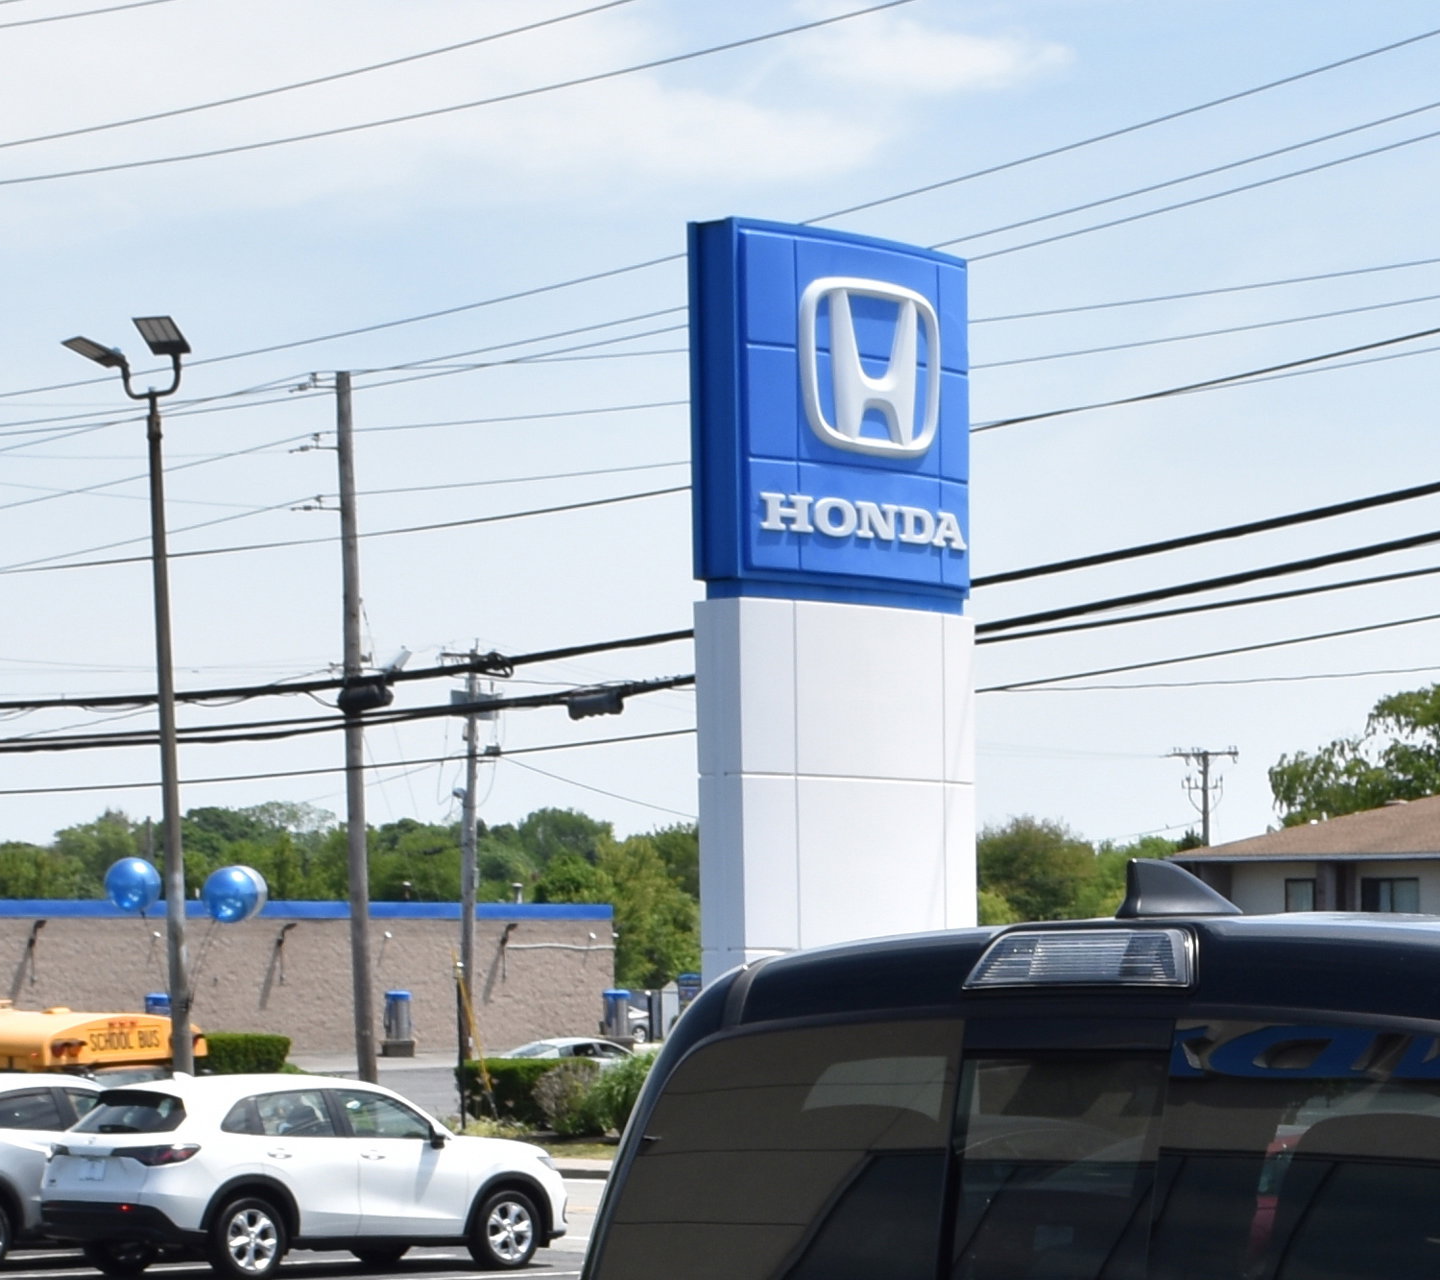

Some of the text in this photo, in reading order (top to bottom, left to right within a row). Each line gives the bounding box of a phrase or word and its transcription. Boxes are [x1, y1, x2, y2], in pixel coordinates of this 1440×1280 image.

[760, 492, 968, 550] HONDA
[89, 1030, 160, 1052] SCHOOL BUS
